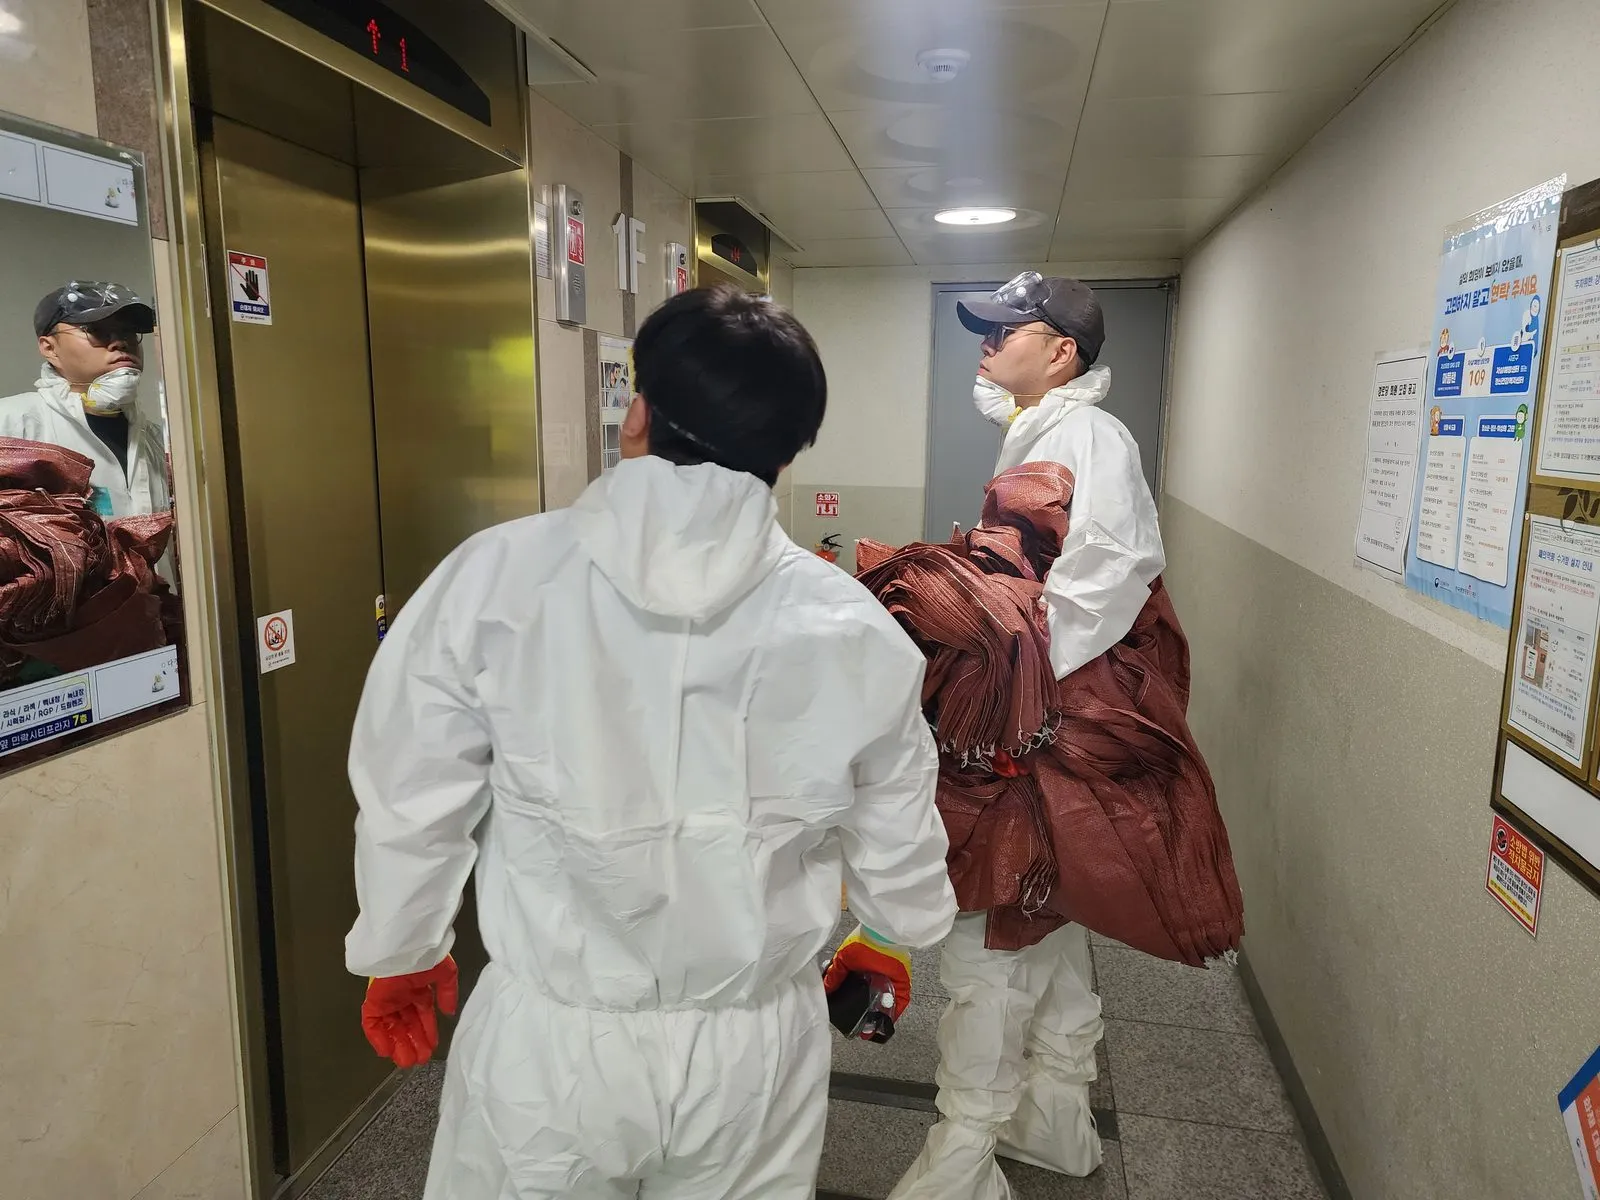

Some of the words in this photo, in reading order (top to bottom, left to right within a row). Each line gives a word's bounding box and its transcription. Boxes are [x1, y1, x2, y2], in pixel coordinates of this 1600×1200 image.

[399, 37, 409, 73] 1
[611, 212, 647, 295] 1F
[1445, 293, 1471, 315] 고민하지
[1472, 287, 1490, 309] 말고
[1491, 282, 1510, 304] 연락
[1512, 275, 1537, 299] 주세요
[1469, 369, 1486, 387] 109
[818, 493, 838, 501] 소화기
[1582, 561, 1593, 573] 안내
[6, 715, 31, 728] 시력검사
[38, 708, 54, 719] RGP
[60, 699, 84, 712] 드림렌즈
[1510, 835, 1527, 859] 소방법
[1529, 848, 1541, 870] 위반
